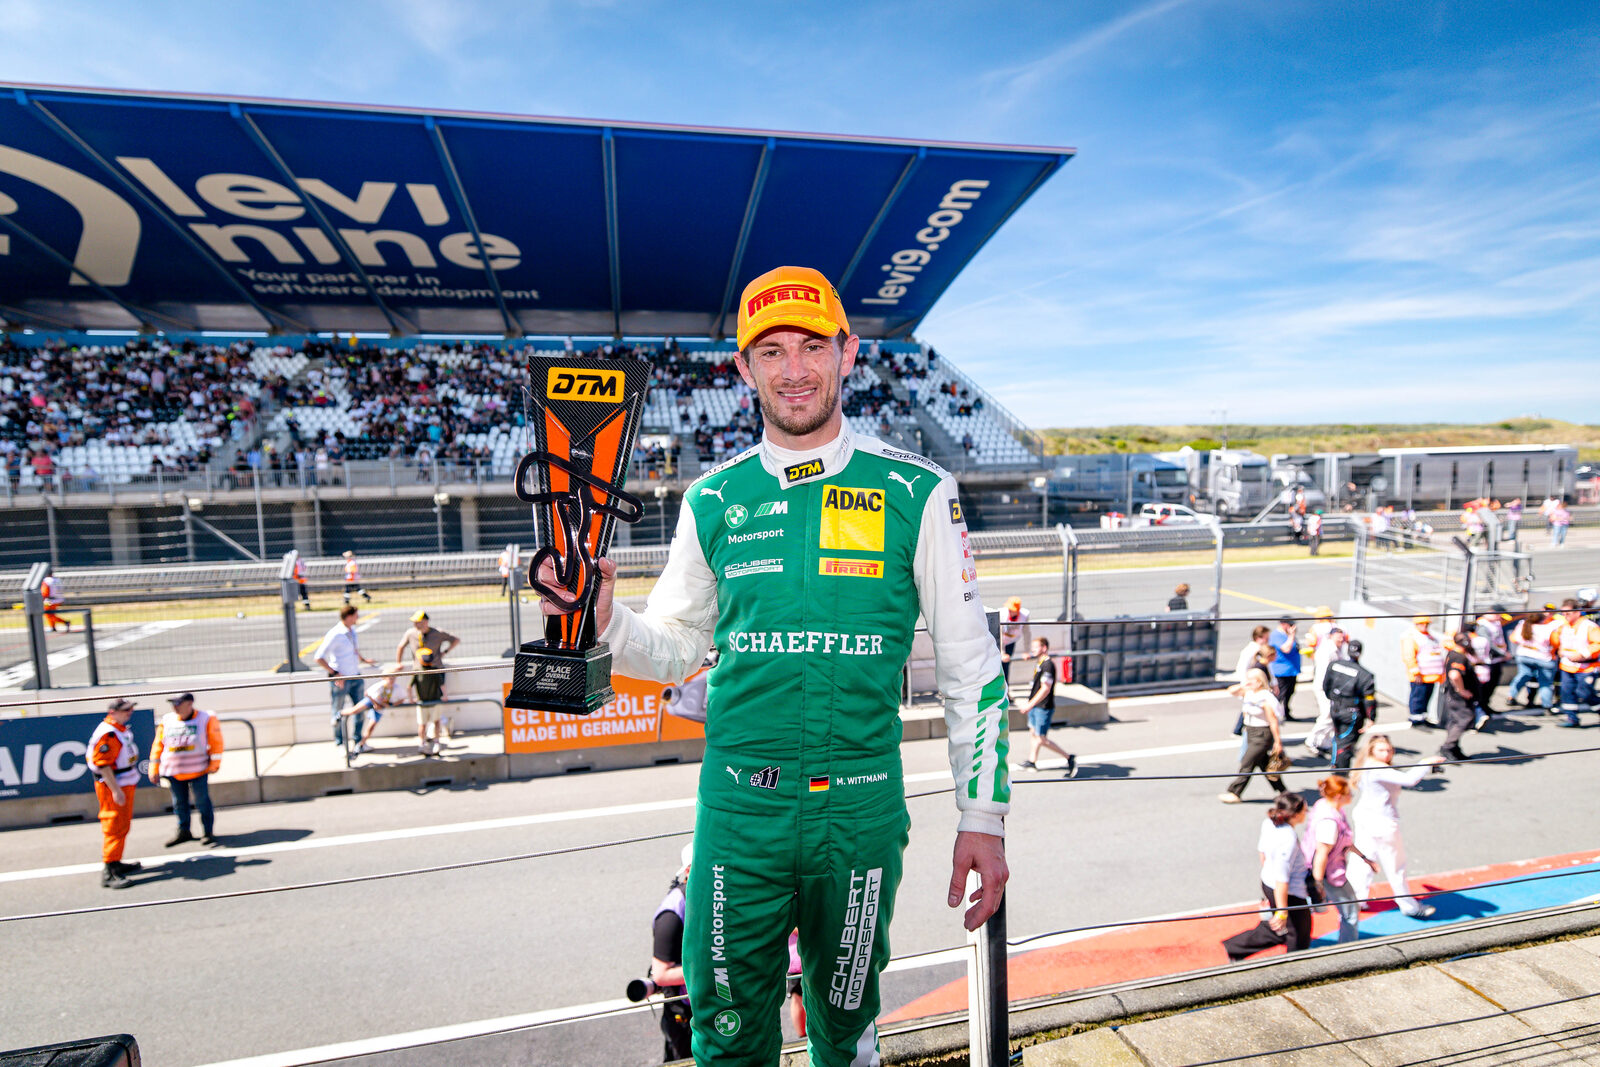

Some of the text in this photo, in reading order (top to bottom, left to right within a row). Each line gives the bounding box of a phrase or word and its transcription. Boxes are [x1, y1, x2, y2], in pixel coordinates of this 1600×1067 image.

[116, 156, 450, 227] levi
[188, 223, 522, 270] nine
[861, 179, 990, 305] levi9.com
[237, 268, 441, 287] Your partner in
[253, 283, 540, 300] software development
[747, 284, 820, 318] PIRELLI
[552, 373, 617, 397] DTM
[789, 461, 822, 480] DTM
[824, 488, 883, 513] ADAC
[727, 528, 785, 545] Motorsport
[724, 558, 784, 572] SCHUBERT
[727, 566, 781, 577] MOTORSPORT
[825, 560, 879, 576] PIRELLI
[728, 631, 883, 656] SCHAEFFLER
[545, 672, 571, 680] OVERALL
[546, 665, 571, 674] PLACE
[511, 717, 657, 743] MADE IN GERMANY
[750, 766, 781, 790] #11
[836, 772, 888, 786] M. WITTMANN
[711, 864, 727, 961] Motorsport
[829, 870, 864, 1009] SCHUBERT
[849, 876, 879, 1004] MOTORSPORT
